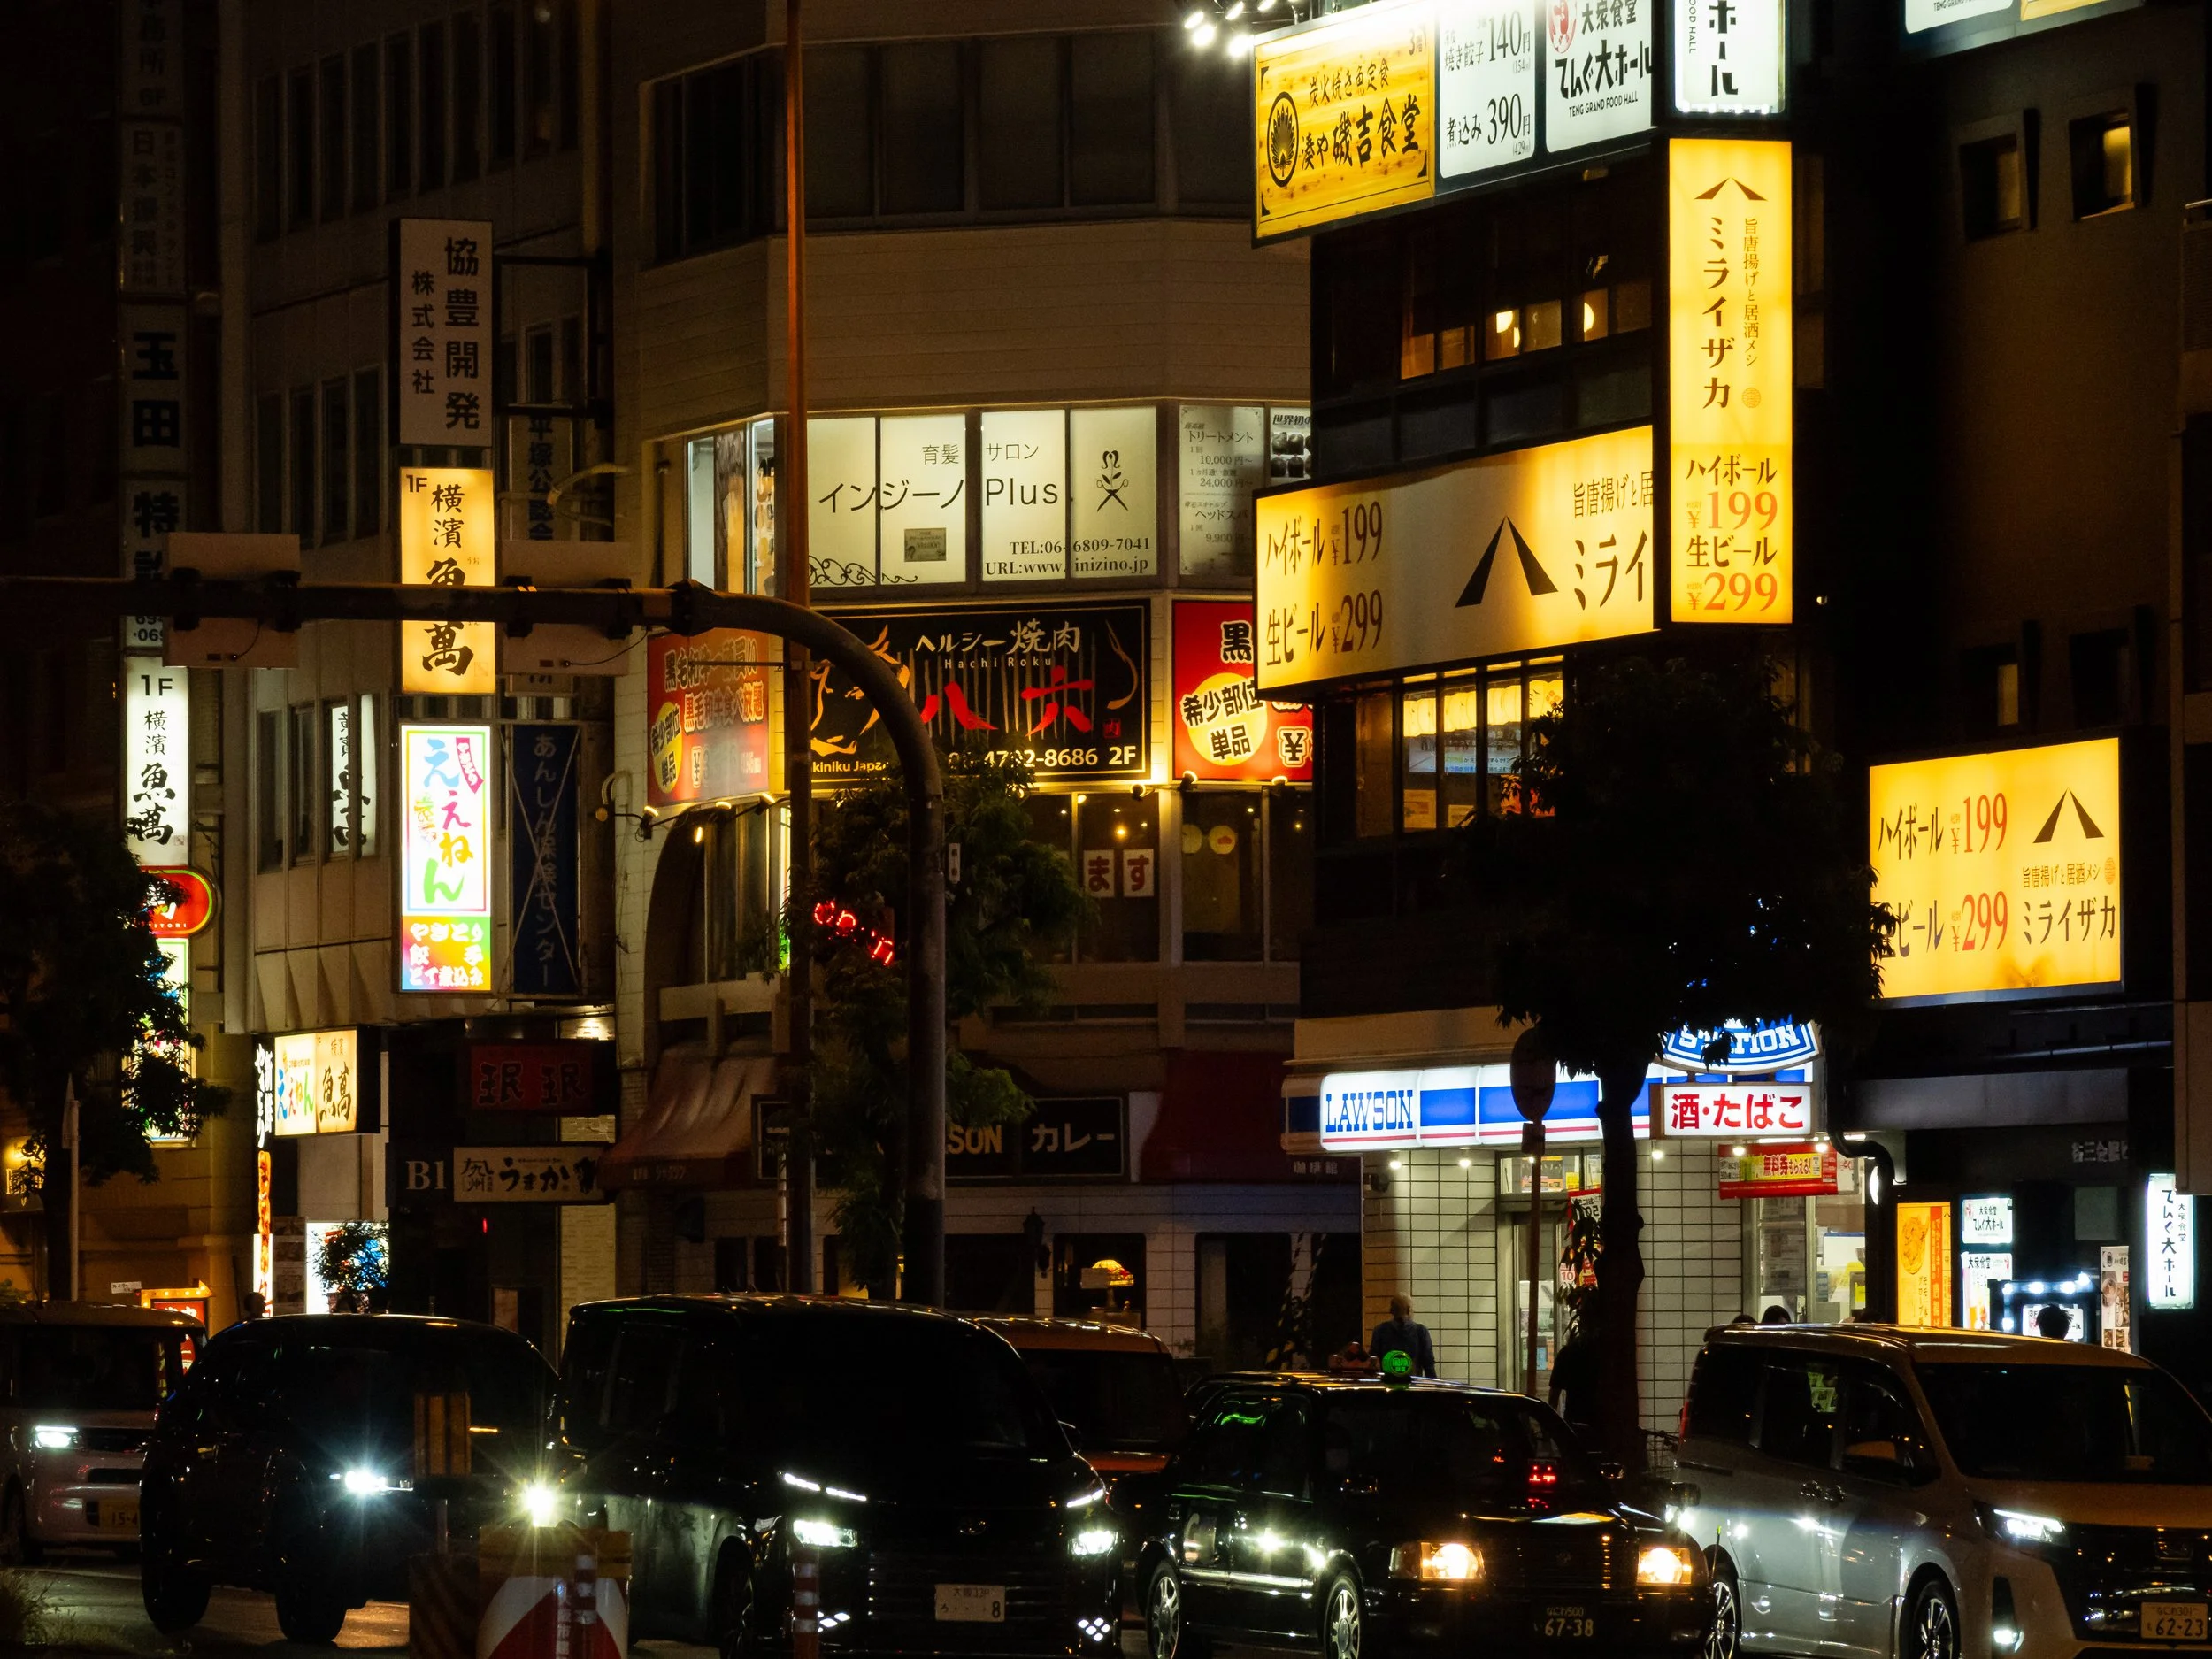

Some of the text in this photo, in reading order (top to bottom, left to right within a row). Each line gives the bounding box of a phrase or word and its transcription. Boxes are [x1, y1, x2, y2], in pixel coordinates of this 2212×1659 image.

[1688, 27, 1697, 53] HALL
[1310, 58, 1389, 107] 炭火焼き魚定食
[1555, 39, 1652, 99] てんぐ大ホール
[1569, 91, 1639, 118] TENG GRAND FOOD HALL
[1446, 113, 1482, 149] 煮込み
[1743, 218, 1759, 367] 旨唐揚げと居酒メシ
[1701, 217, 1734, 409] ミライザカ
[411, 271, 434, 395] 株式会社
[445, 237, 480, 430] 協豊開発
[133, 331, 179, 447] 玉田
[922, 442, 1039, 465] 育髪 サロン
[1188, 431, 1254, 444] トリートメント
[406, 474, 427, 493] 1F
[1686, 454, 1778, 486] ハイボール
[819, 478, 1058, 512] インジーノ Plus
[1195, 510, 1248, 520] ヘッドスパ
[1266, 516, 1325, 575] ハイボール
[1686, 534, 1778, 567] 生ビール
[1574, 530, 1647, 611] ミライ
[916, 618, 1080, 655] ヘルシー焼肉
[1266, 601, 1325, 666] 生ビール
[944, 656, 1053, 669] Hachi Roku
[141, 675, 173, 696] 1F
[920, 665, 1094, 737] 八六
[1183, 680, 1265, 726] 希少部位
[1109, 746, 1136, 765] 2F
[1210, 725, 1252, 760] 単品
[423, 737, 473, 904] ええねん
[1878, 803, 1944, 860] ハイボール
[534, 733, 557, 988] あんしん保険センター
[1088, 854, 1151, 893] ます
[2023, 862, 2101, 889] 旨唐揚げと居酒メシ
[2024, 895, 2116, 945] ミライザカ
[1325, 1089, 1414, 1132] LAWSON
[1671, 1094, 1804, 1130] 酒・たばこ
[1032, 1122, 1115, 1153] カレー
[406, 1159, 447, 1190] B1
[2161, 1189, 2177, 1298] てんぐ大ホール
[1544, 1617, 1594, 1638] 67-38
[2155, 1617, 2204, 1636] 62-23
